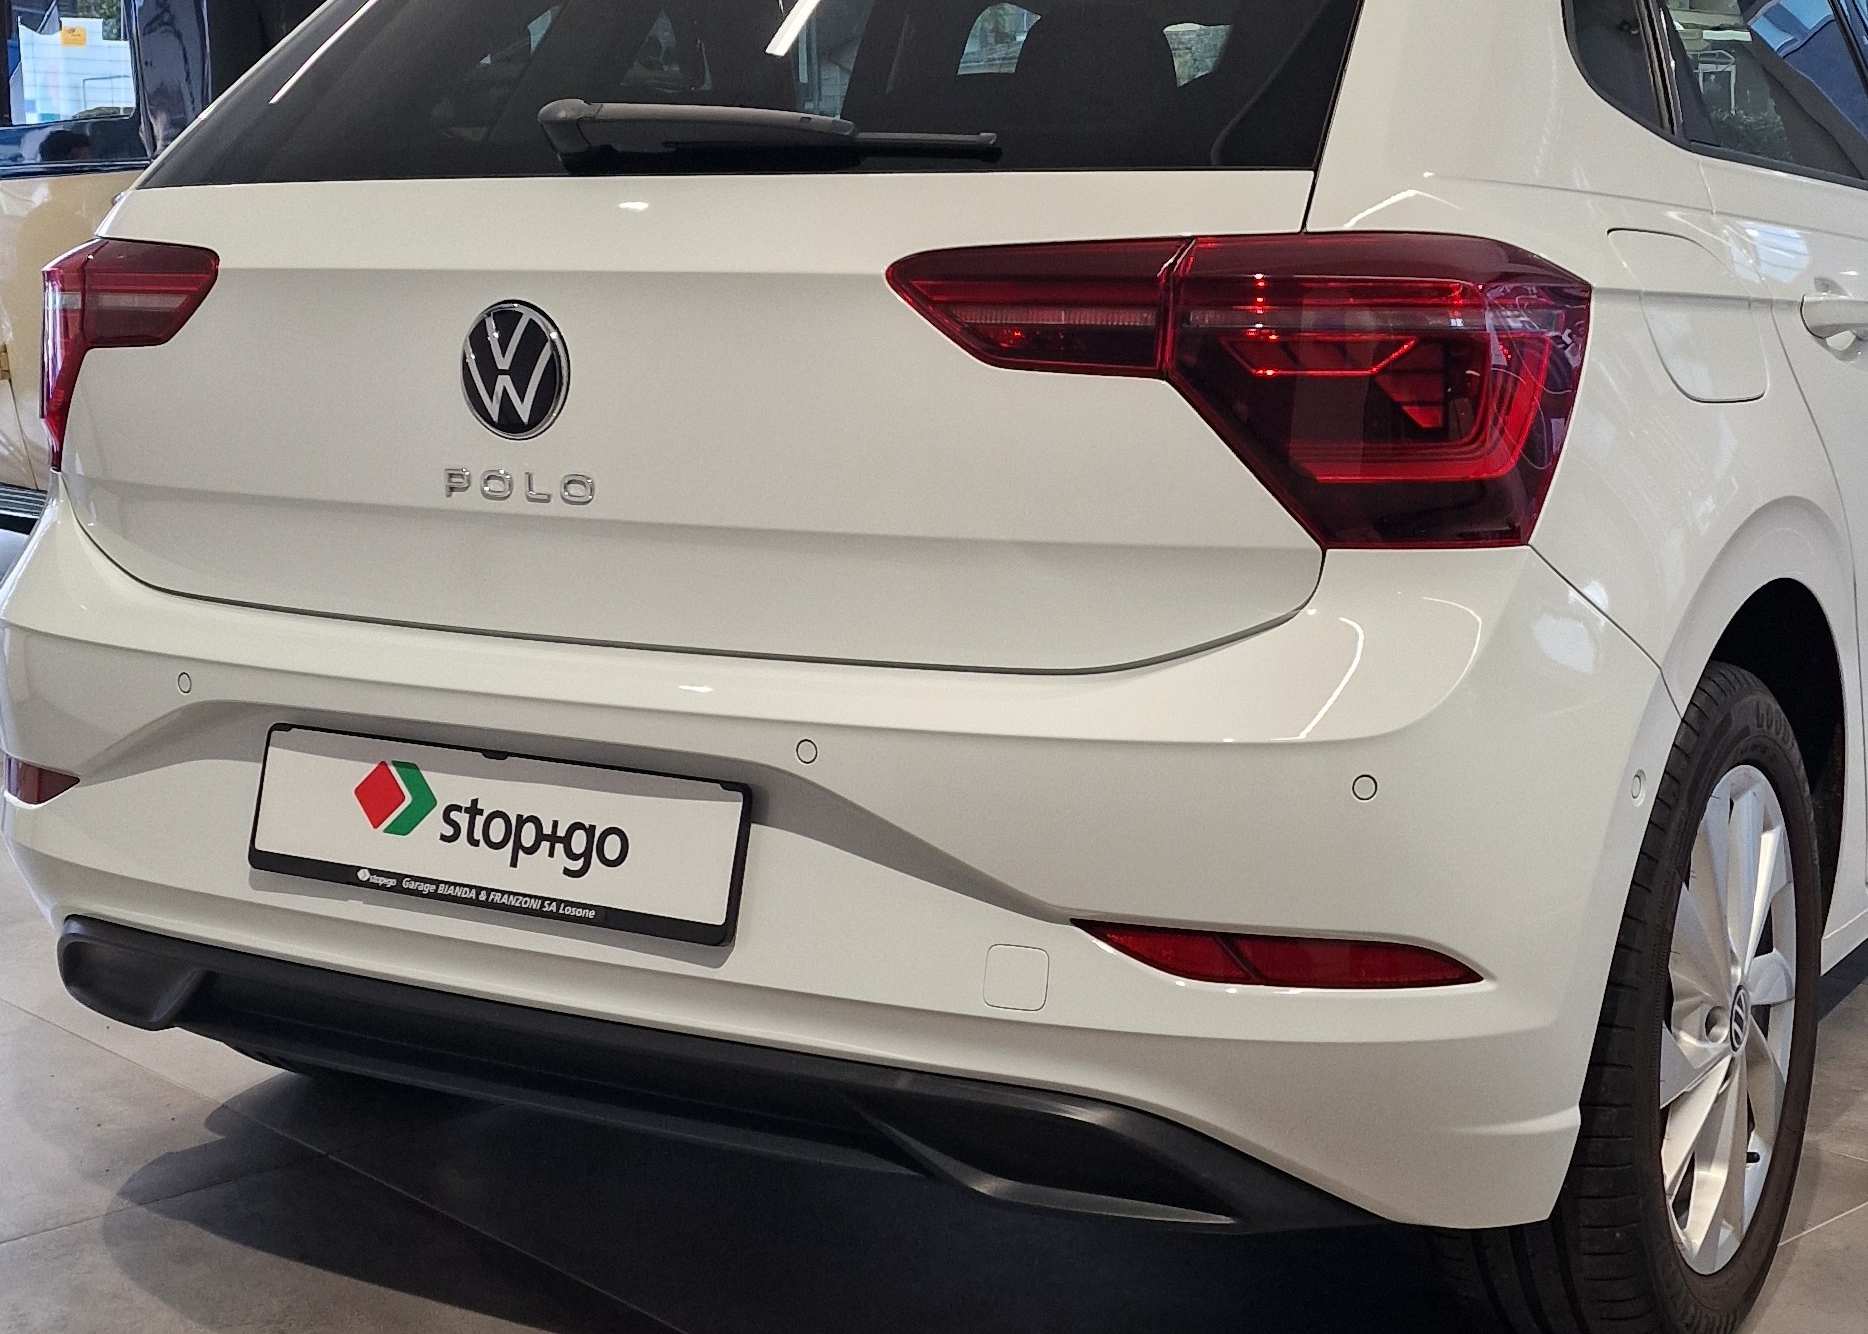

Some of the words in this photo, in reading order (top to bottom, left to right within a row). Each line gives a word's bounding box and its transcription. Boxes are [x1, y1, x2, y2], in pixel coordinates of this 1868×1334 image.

[444, 468, 595, 505] POLO
[439, 797, 630, 878] stop+go
[402, 877, 437, 894] Garage
[437, 883, 476, 900] BIANDA
[478, 890, 487, 901] &
[488, 891, 541, 910] FRANZONI
[542, 900, 556, 912] SA
[558, 903, 595, 919] Losone
